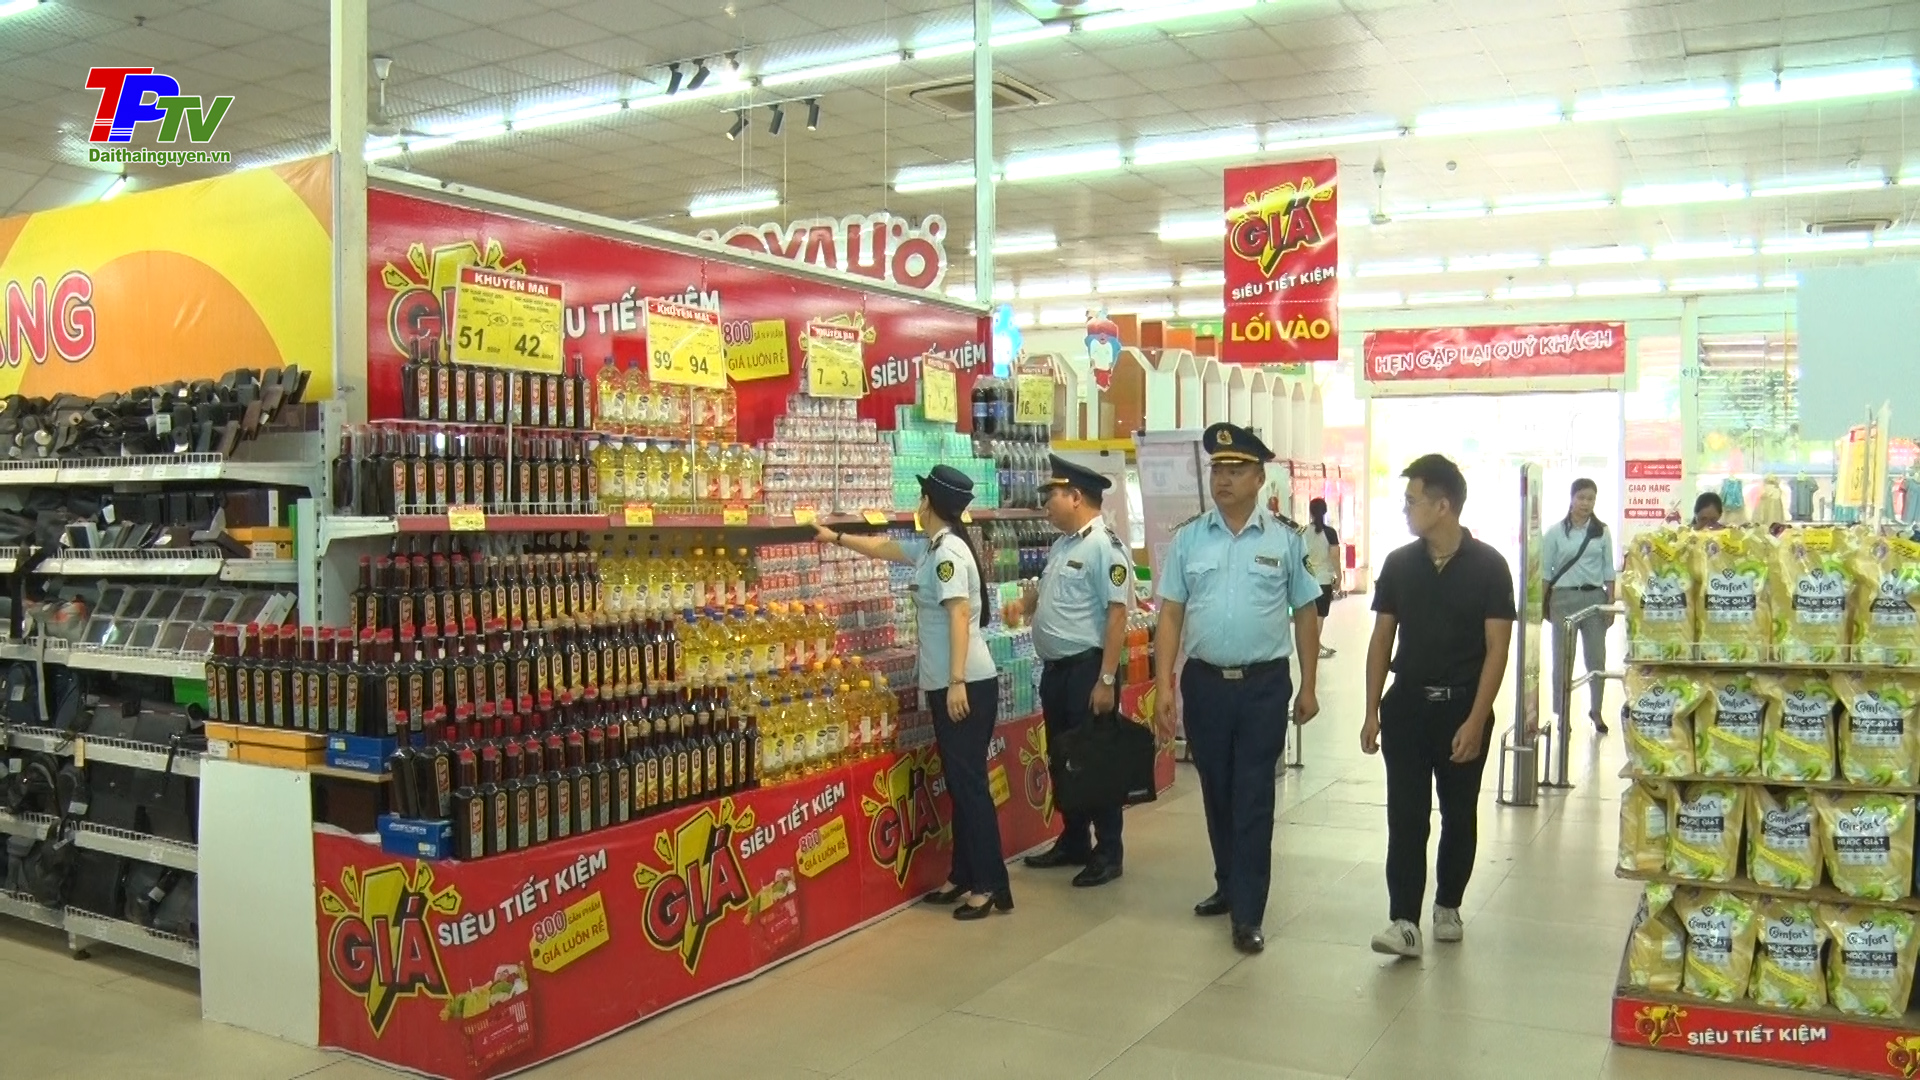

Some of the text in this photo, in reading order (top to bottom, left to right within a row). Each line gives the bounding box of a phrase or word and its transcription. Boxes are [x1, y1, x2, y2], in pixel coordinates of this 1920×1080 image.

[1234, 197, 1321, 258] GIÁ
[1232, 267, 1336, 300] SIÊU TIẾT KIỆM
[0, 270, 96, 368] NG
[723, 320, 753, 346] 800
[1231, 312, 1331, 341] LỐI VÀO
[458, 326, 540, 357] 51 42
[1374, 330, 1613, 376] HẸN GẶP LẠI QUÝ KHÁCH
[654, 349, 709, 375] 99 94
[728, 355, 745, 371] GIÁ
[747, 353, 773, 369] LUÔN
[871, 356, 909, 390] SIÊU
[952, 340, 986, 373] KIỆM
[841, 370, 849, 387] 3
[1628, 484, 1646, 493] GIAO
[1710, 577, 1748, 593] Comfort
[740, 781, 845, 860] SIÊU TIẾT KIỆM
[872, 768, 940, 864] GIÁ
[798, 828, 822, 853] 800
[804, 853, 816, 872] GIÁ
[437, 848, 608, 948] SIÊU TIẾT KIỆM
[648, 827, 748, 943] GIÁ
[333, 894, 440, 987] GIÁ
[532, 910, 567, 945] 800
[542, 913, 606, 966] GIÁ LUÔN RẺ
[1768, 926, 1809, 940] Comfort
[1637, 1010, 1681, 1037] GIÁ
[1687, 1024, 1827, 1046] SIÊU TIẾT KIỆM
